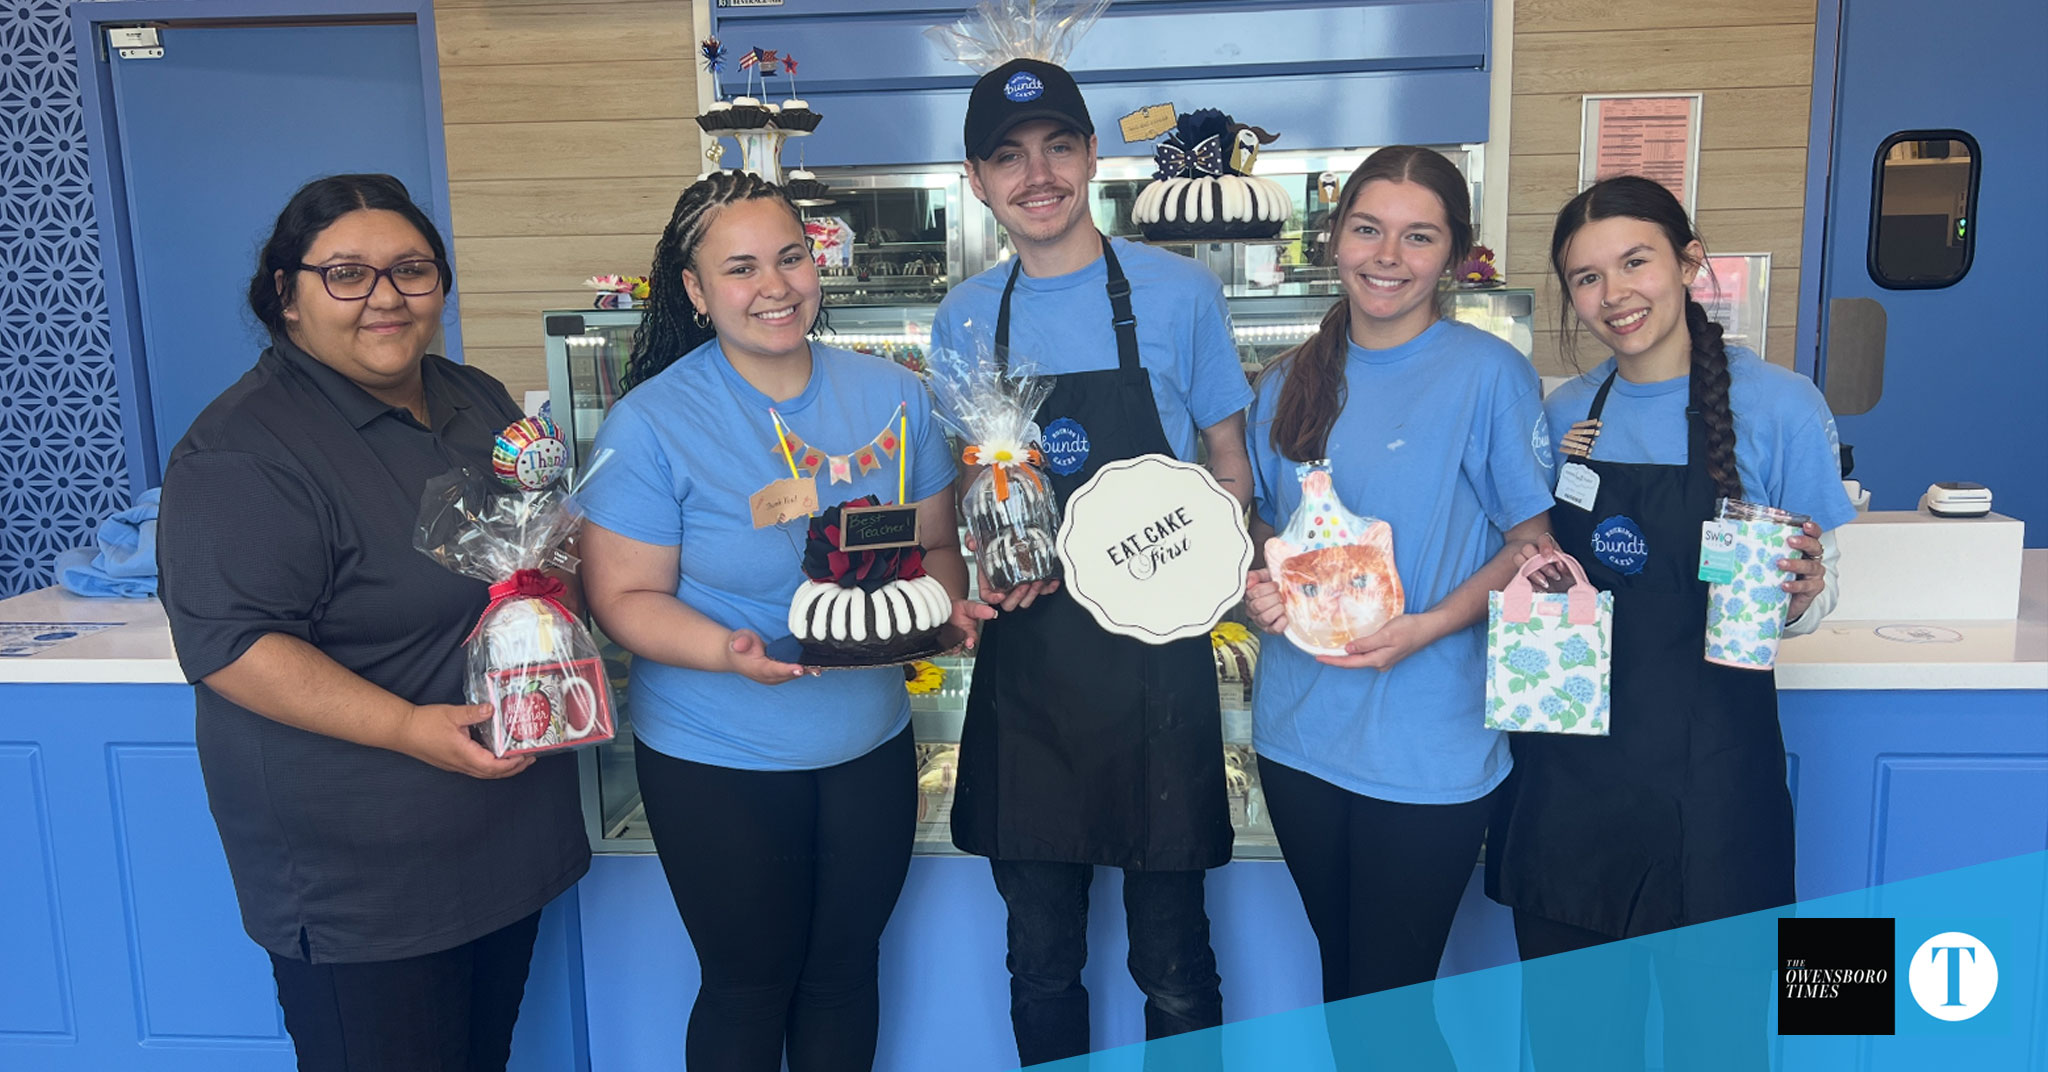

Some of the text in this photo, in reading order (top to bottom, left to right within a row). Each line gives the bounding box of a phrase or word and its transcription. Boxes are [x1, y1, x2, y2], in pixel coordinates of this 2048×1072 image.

[1003, 78, 1044, 95] bundt
[1041, 433, 1089, 454] bundt
[849, 513, 886, 529] Best
[856, 516, 911, 540] Teacher!
[1106, 506, 1193, 566] EAT CAKE
[1591, 532, 1648, 555] bundt
[1128, 533, 1191, 581] First
